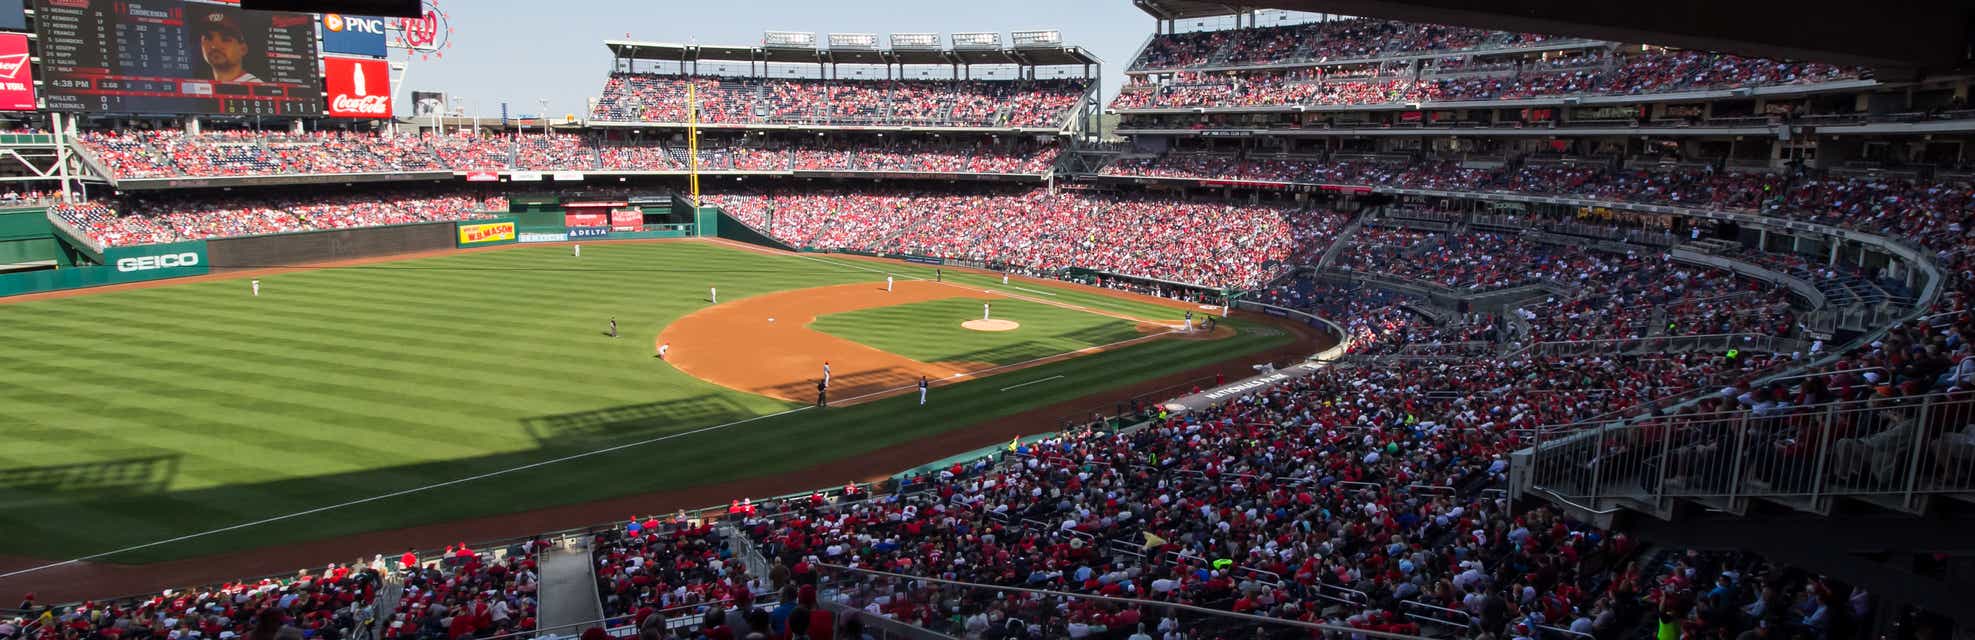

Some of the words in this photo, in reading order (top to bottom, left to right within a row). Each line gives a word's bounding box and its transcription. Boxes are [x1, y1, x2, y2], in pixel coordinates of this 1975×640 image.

[344, 17, 383, 34] PNC
[333, 94, 388, 114] Coca-Cola
[578, 229, 607, 237] DELTA
[117, 252, 199, 272] GEICO
